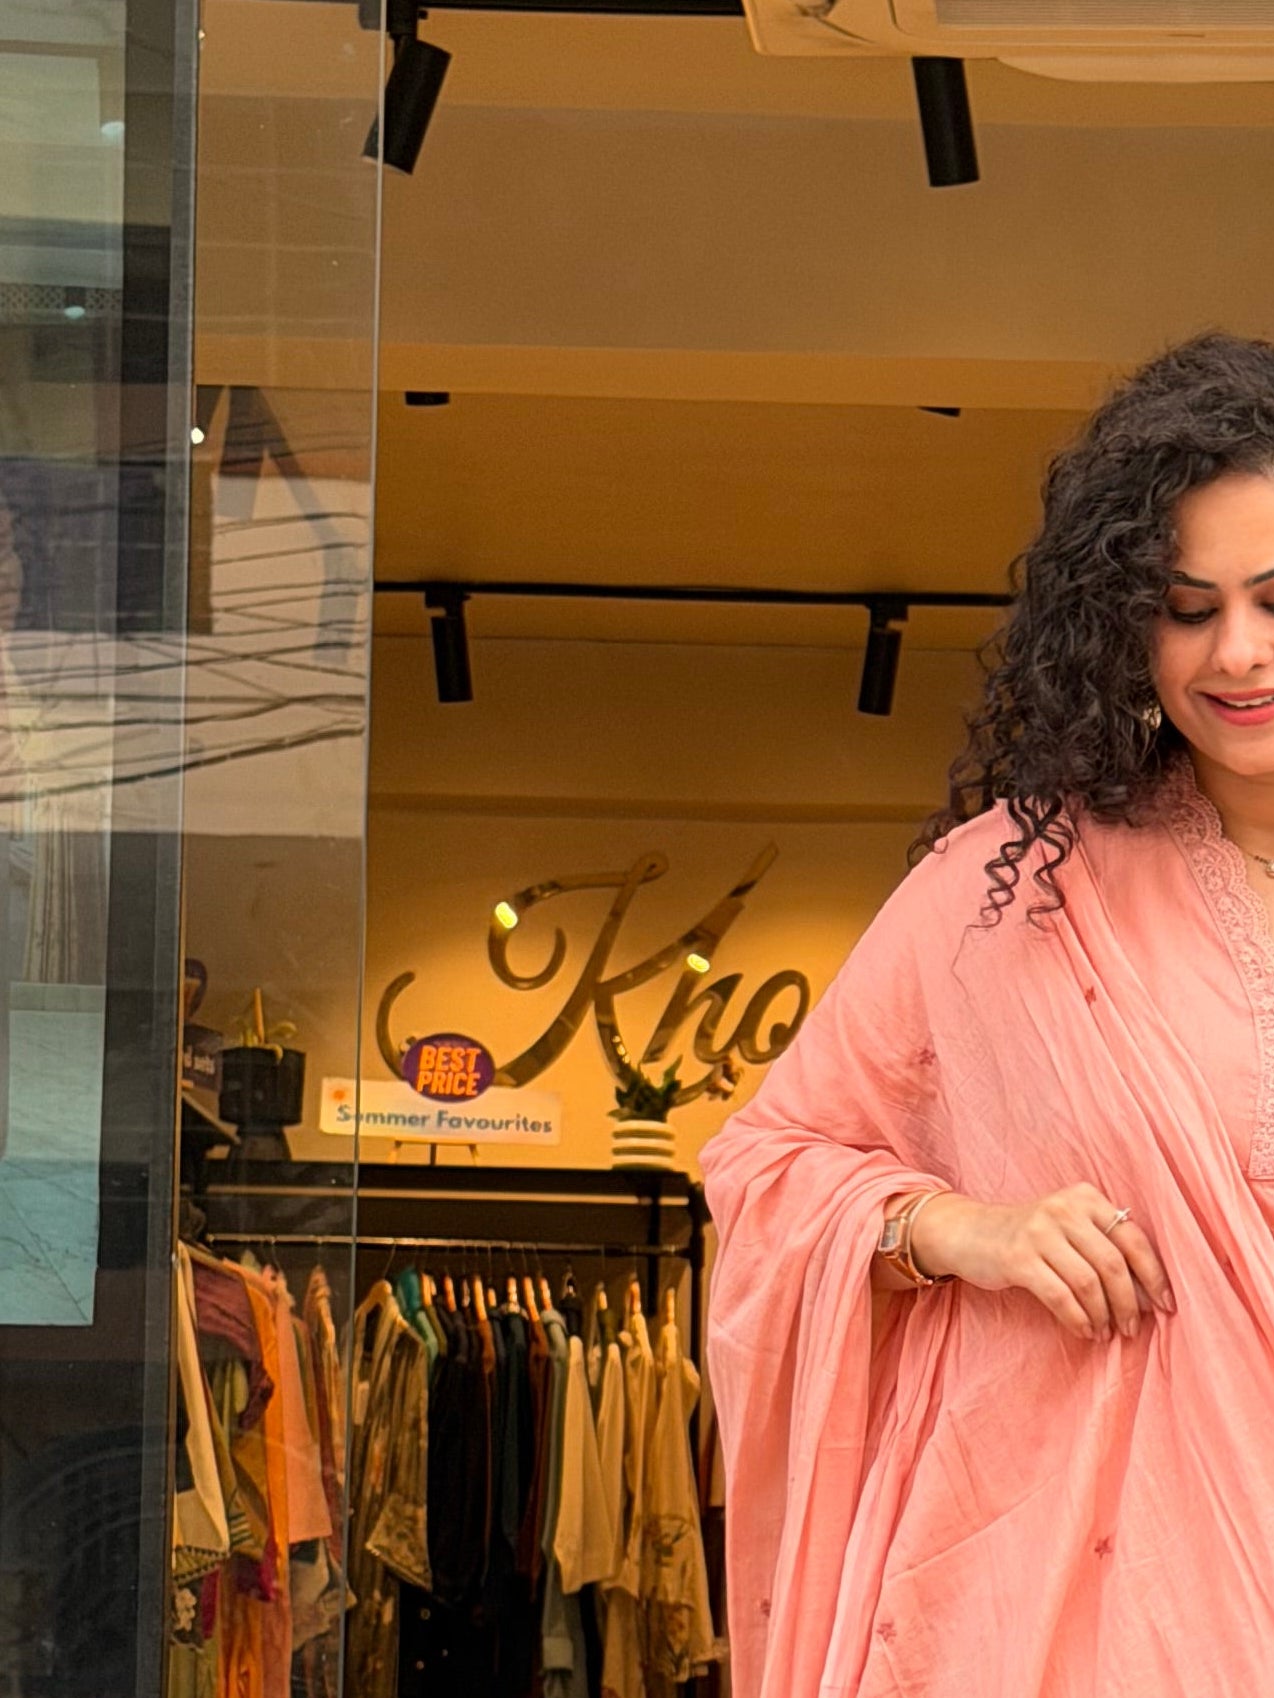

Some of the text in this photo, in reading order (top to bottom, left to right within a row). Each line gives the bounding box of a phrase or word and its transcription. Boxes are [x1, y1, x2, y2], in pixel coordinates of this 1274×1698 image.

[420, 1046, 481, 1072] BEST
[417, 1072, 480, 1096] PRICE
[438, 1110, 552, 1133] Favourites
